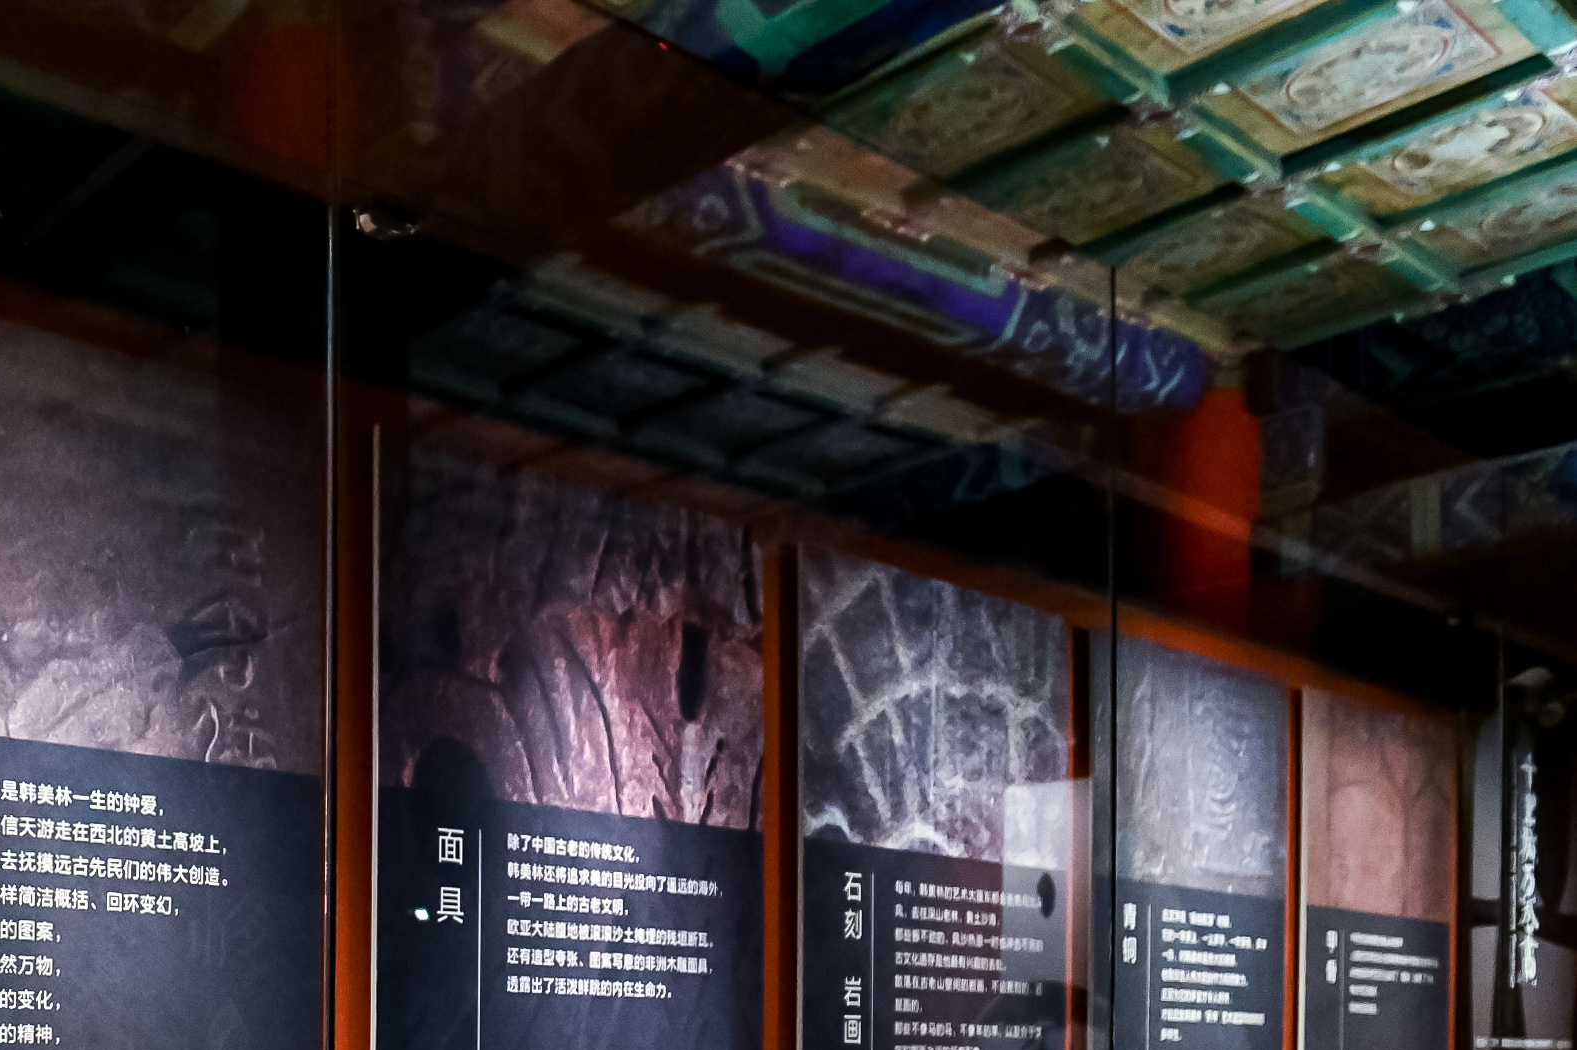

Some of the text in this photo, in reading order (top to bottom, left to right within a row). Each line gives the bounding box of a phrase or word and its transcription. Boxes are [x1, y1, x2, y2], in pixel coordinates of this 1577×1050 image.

[436, 827, 465, 924] 面具
[843, 871, 863, 1044] 石刻 岩画
